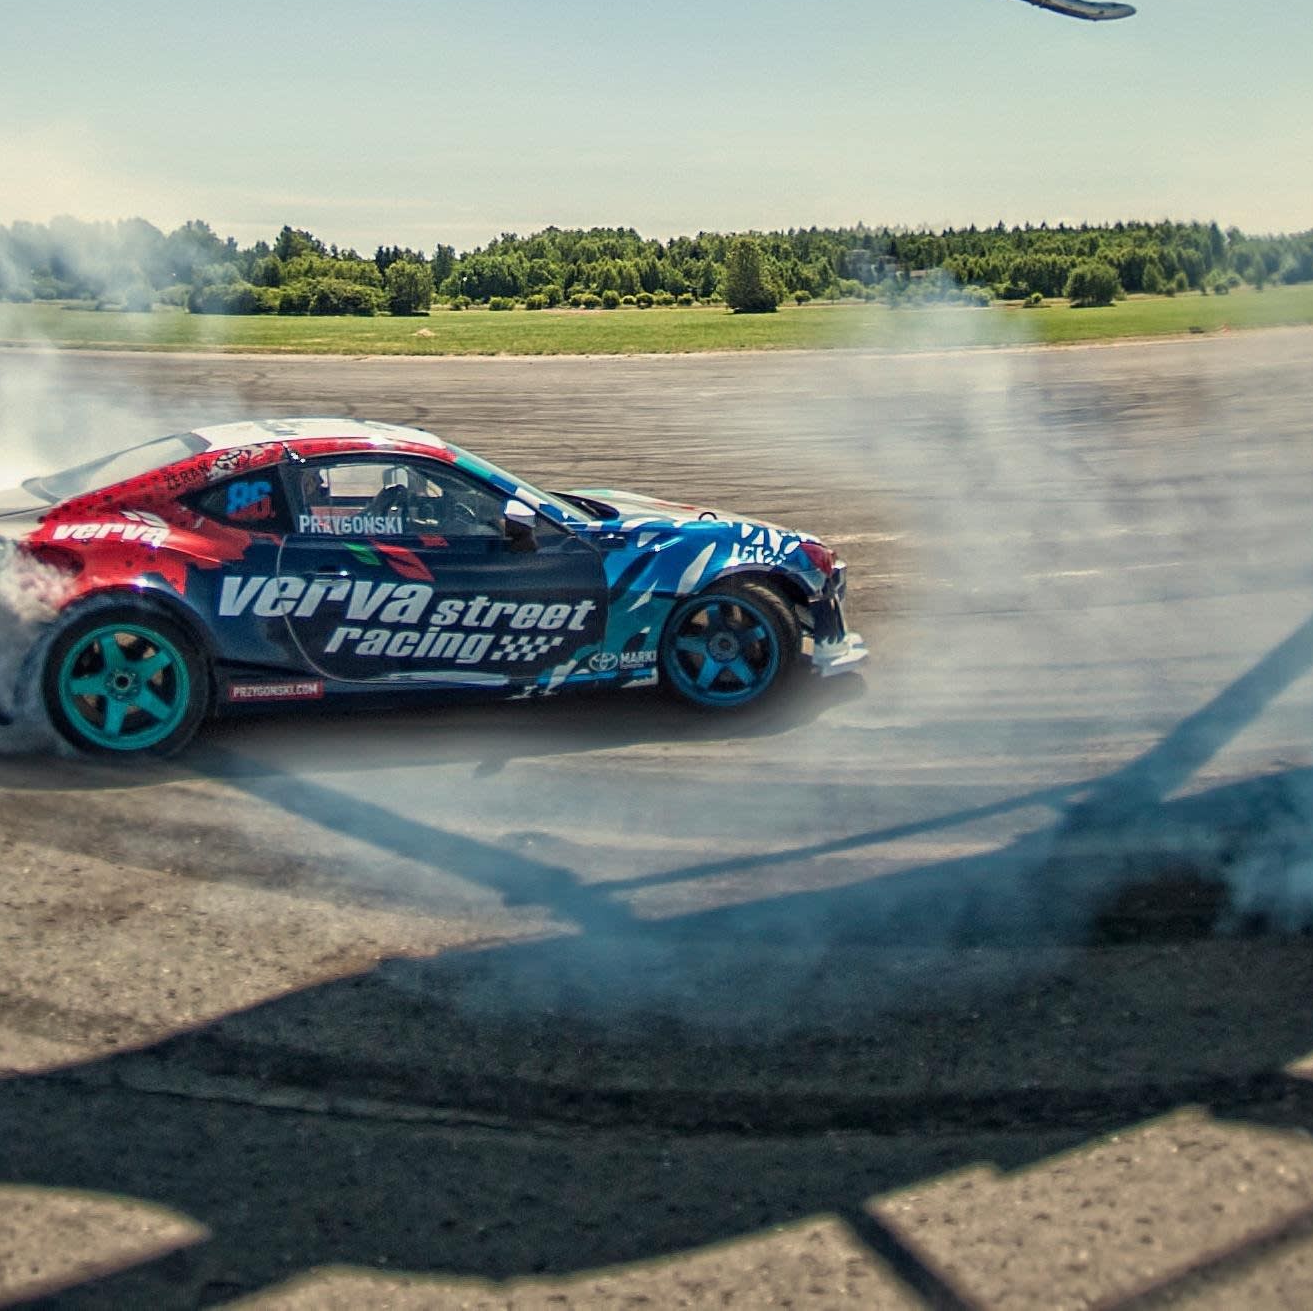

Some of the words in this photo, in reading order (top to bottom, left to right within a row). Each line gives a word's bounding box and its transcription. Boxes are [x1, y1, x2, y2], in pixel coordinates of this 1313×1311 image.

[52, 521, 169, 546] verva
[218, 576, 433, 625] verva
[430, 594, 597, 632] street
[324, 626, 497, 665] racing
